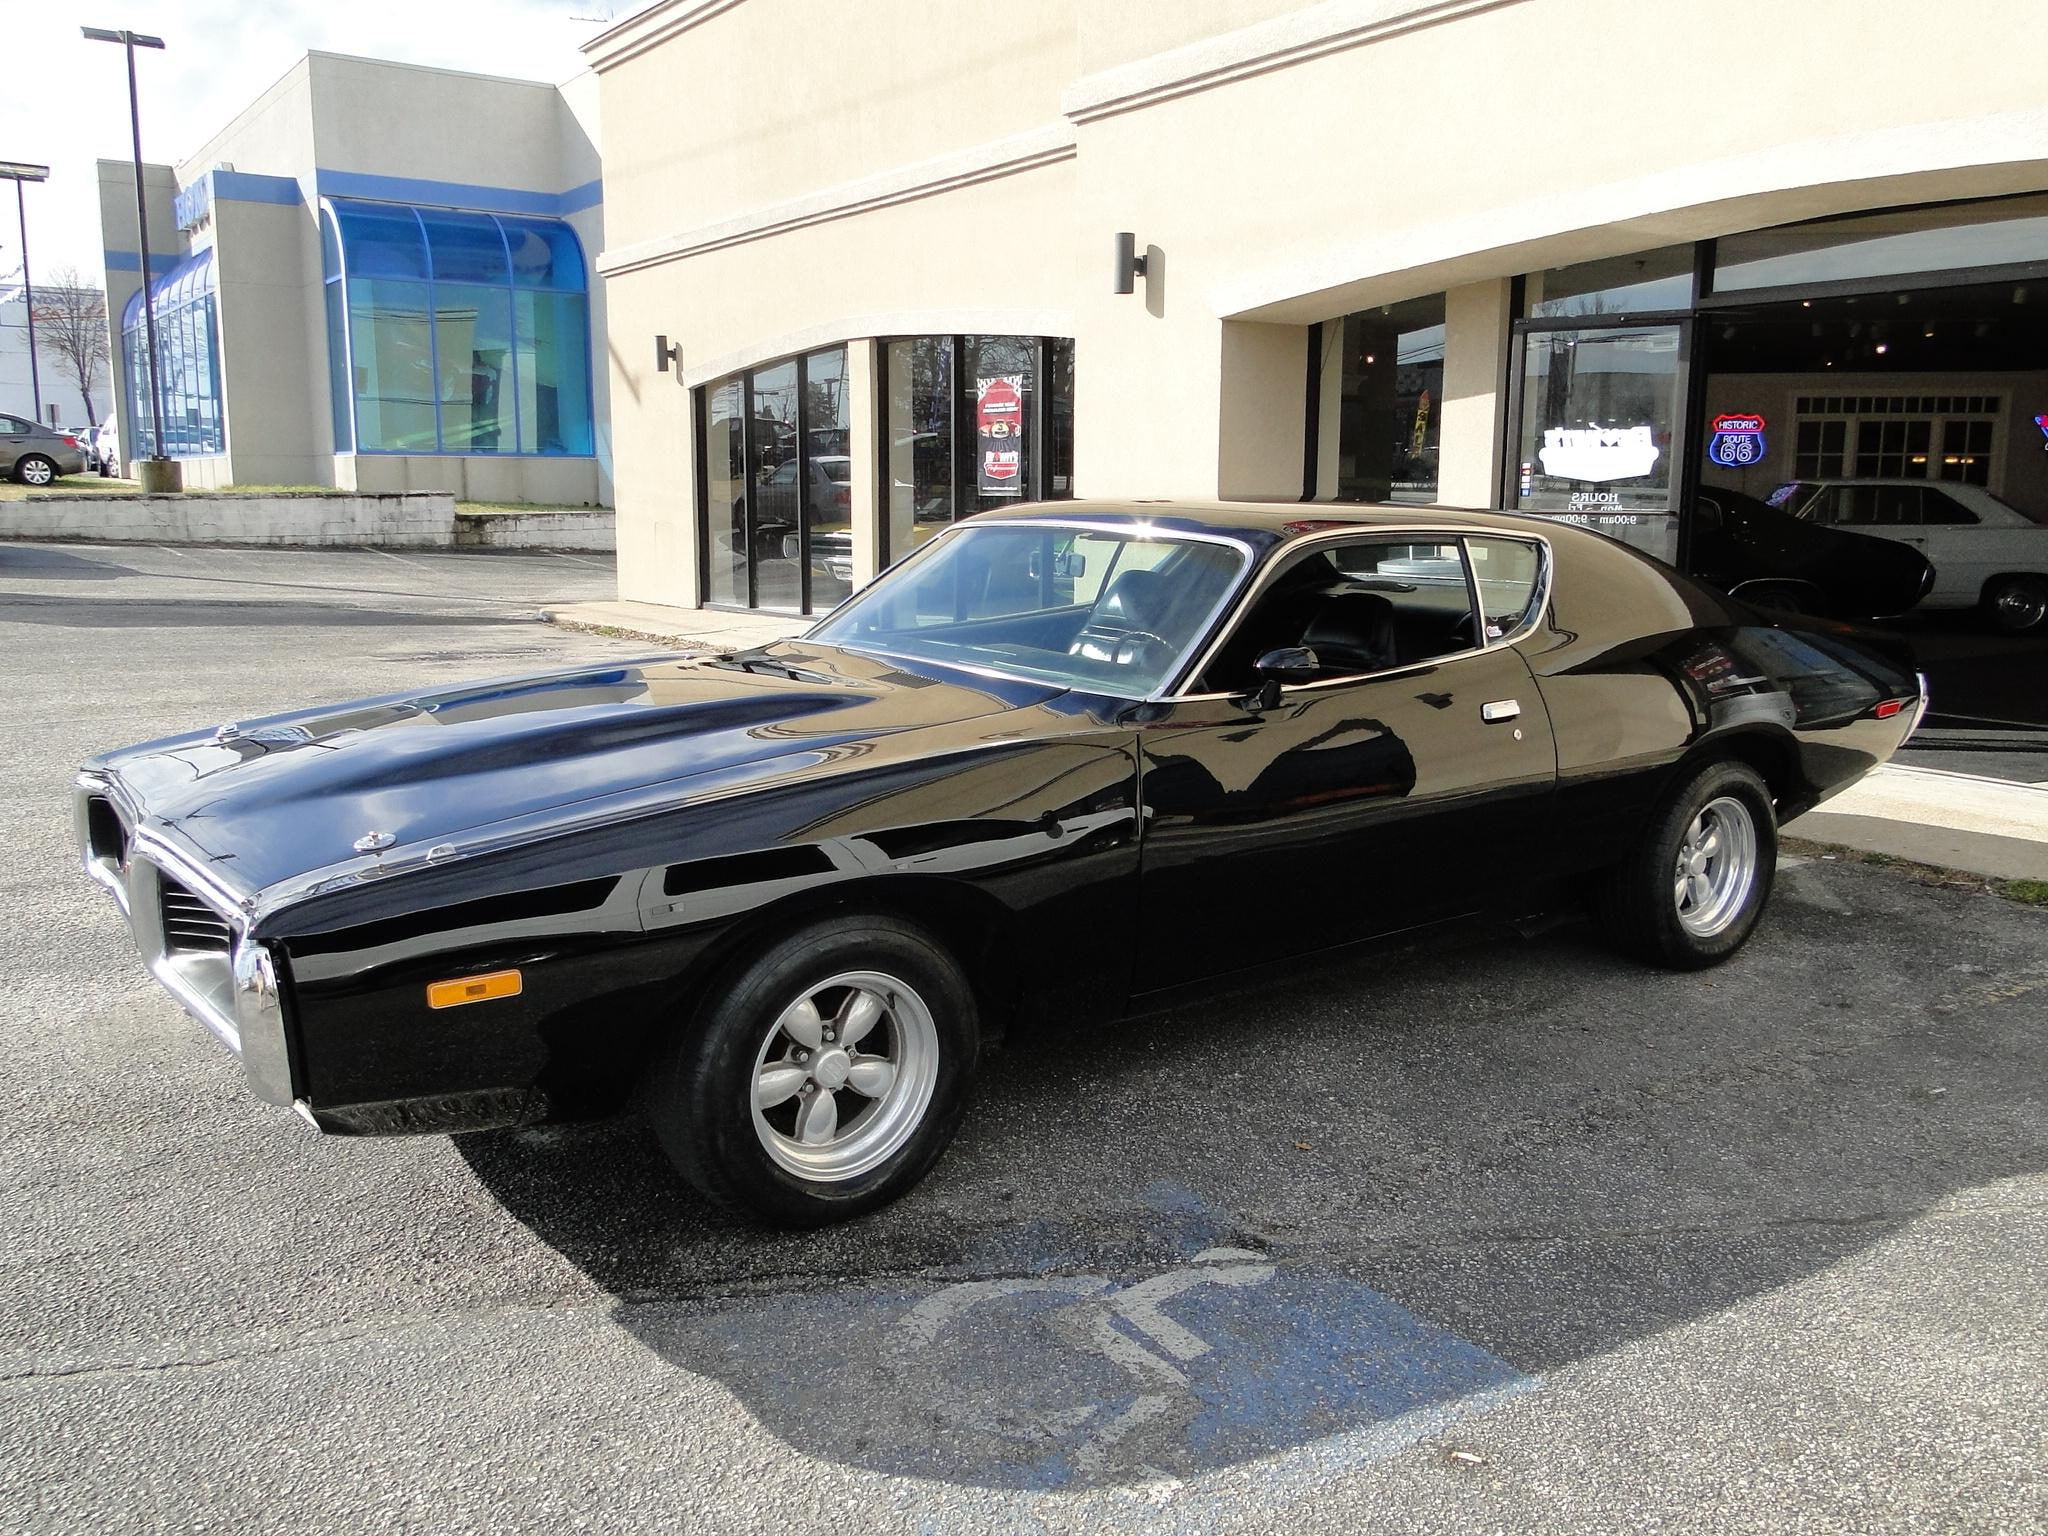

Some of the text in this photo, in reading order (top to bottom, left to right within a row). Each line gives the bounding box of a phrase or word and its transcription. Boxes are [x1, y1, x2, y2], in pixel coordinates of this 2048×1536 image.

[1718, 420, 1758, 430] HISTORIC
[1723, 435, 1751, 443] ROUTE
[1720, 443, 1752, 462] 66
